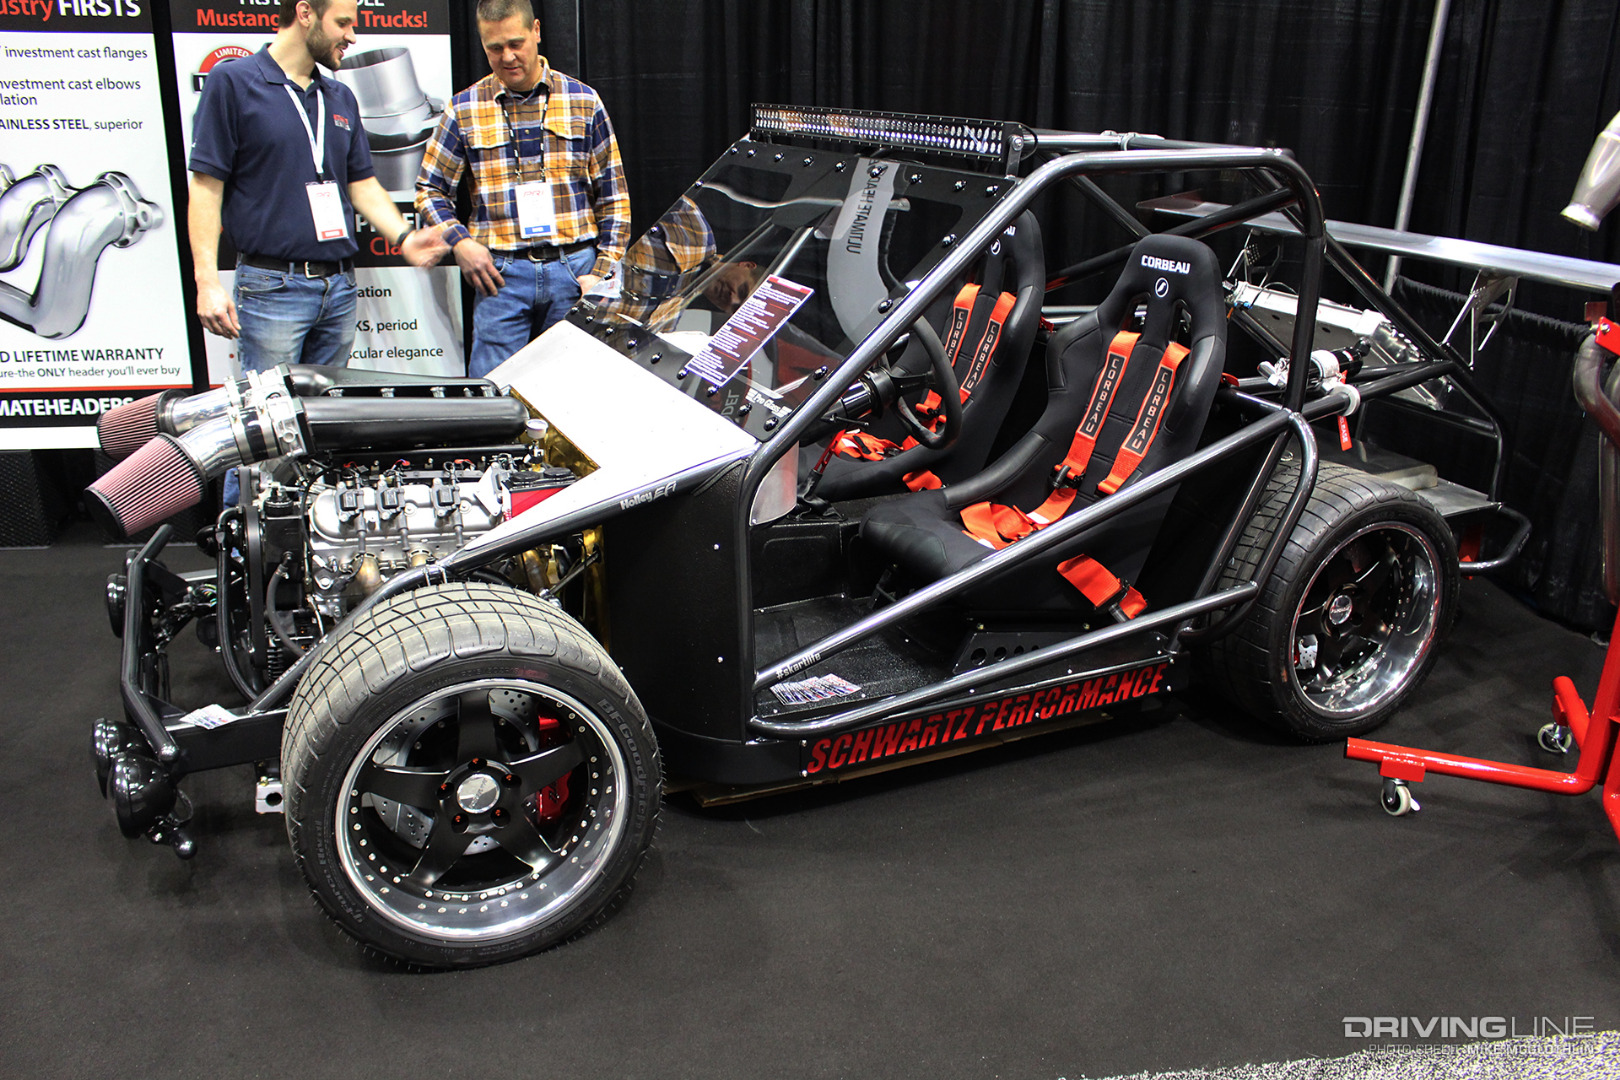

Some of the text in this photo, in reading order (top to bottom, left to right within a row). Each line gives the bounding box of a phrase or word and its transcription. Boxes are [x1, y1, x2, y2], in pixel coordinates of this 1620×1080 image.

[57, 0, 141, 17] FIRSTS
[360, 10, 428, 28] Trucks!
[4, 46, 148, 61] investment cast flanges
[214, 47, 251, 59] LIMITED
[68, 79, 93, 90] cast
[95, 78, 141, 90] elbows
[52, 119, 92, 131] STEEL,
[94, 119, 143, 132] superior
[1141, 254, 1191, 274] CORBEAU
[357, 286, 392, 298] ation
[376, 318, 418, 334] period
[13, 349, 79, 362] LIFETIME
[81, 347, 164, 361] WARRANTY
[386, 346, 444, 361] elegance
[966, 324, 997, 389] CORBEAU
[37, 367, 66, 377] ONLY
[68, 366, 104, 376] header
[107, 366, 134, 378] you'll
[136, 367, 158, 376] ever
[161, 365, 181, 376] buy
[1085, 358, 1120, 433] CORBEAU
[1131, 372, 1169, 450] CORBEAU
[620, 491, 653, 510] Holley
[807, 663, 1168, 773] SCHWARTZ PERFORMANCE
